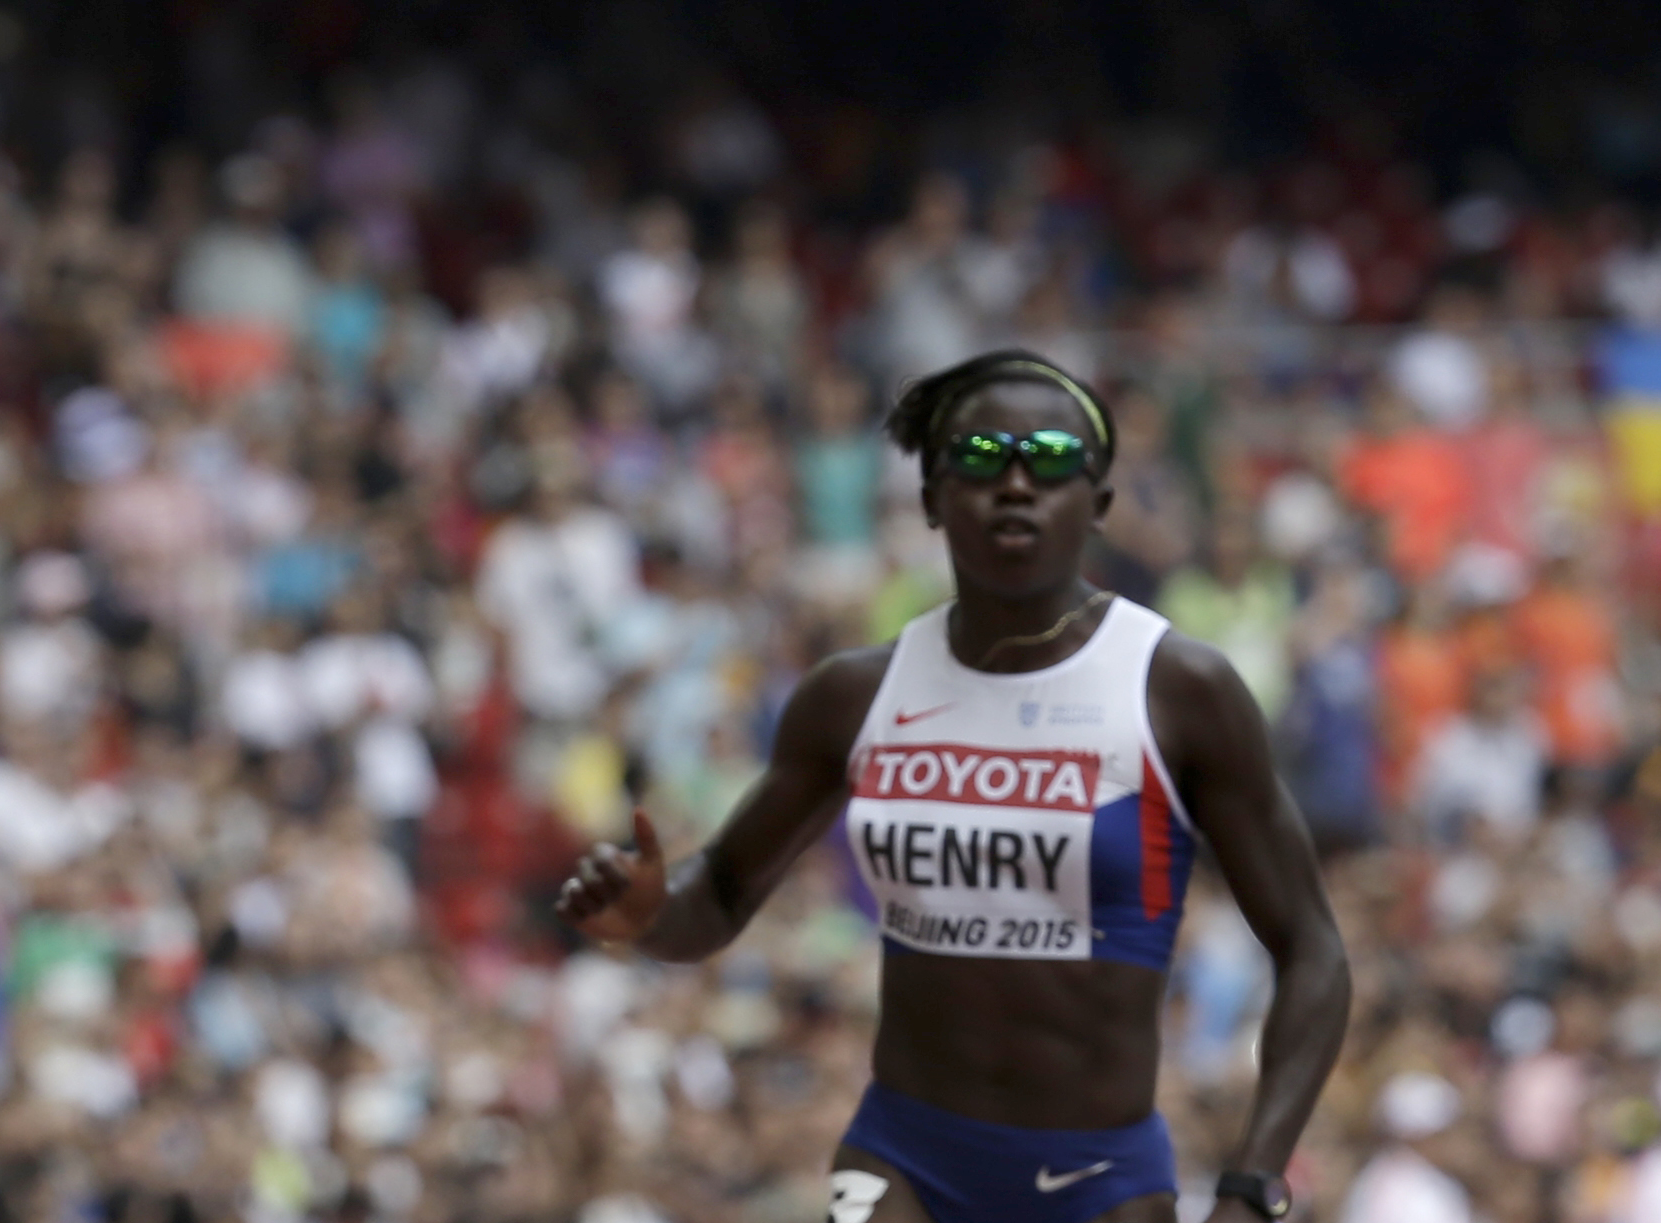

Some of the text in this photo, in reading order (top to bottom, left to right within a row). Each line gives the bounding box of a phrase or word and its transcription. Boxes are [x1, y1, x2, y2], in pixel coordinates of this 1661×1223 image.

[875, 750, 1089, 807] TOYOTA
[863, 821, 1071, 893] HENRY
[885, 902, 1079, 949] BEIJING 2015
